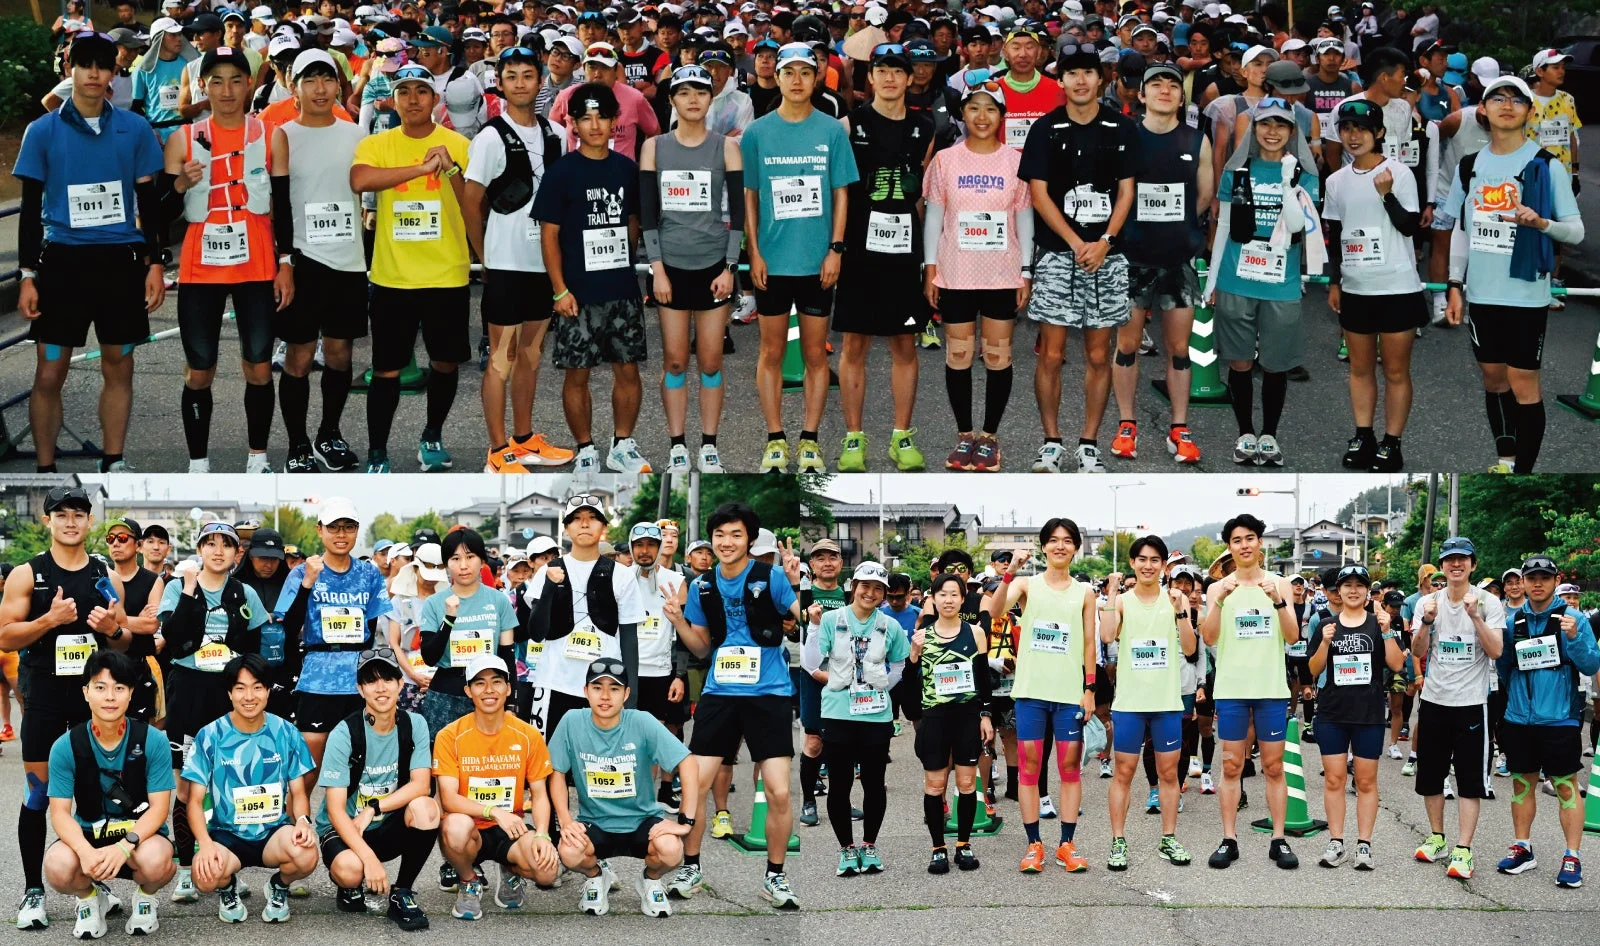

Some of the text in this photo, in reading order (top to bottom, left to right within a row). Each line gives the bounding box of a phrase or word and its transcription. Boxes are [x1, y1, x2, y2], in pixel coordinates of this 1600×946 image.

[764, 155, 826, 166] ULTRAMARATHON
[958, 174, 1004, 186] NAGOYA
[586, 188, 602, 201] RUN
[668, 188, 690, 196] 3001
[812, 192, 818, 200] A
[113, 198, 120, 206] A
[780, 194, 802, 204] 1002
[1144, 199, 1166, 208] 1004
[1176, 198, 1181, 206] A
[78, 200, 103, 211] 1011
[592, 202, 598, 212] &
[1072, 200, 1093, 208] 1001
[313, 219, 337, 228] 1014
[346, 218, 352, 226] A
[399, 218, 421, 226] 1062
[432, 216, 438, 224] B
[588, 212, 608, 226] TRAIL
[874, 228, 896, 238] 1007
[964, 227, 988, 236] 3004
[998, 226, 1003, 234] A
[1478, 228, 1500, 238] 1010
[207, 241, 230, 250] 1015
[240, 238, 246, 246] A
[1373, 242, 1380, 250] A
[592, 245, 615, 255] 1019
[1345, 244, 1364, 252] 3002
[1244, 255, 1267, 266] 3005
[1276, 258, 1282, 266] A
[312, 590, 370, 605] SAROMA
[958, 612, 977, 620] Style
[328, 622, 347, 630] 1057
[356, 620, 361, 628] B
[1240, 620, 1258, 628] 5005
[572, 637, 592, 646] 1063
[1036, 633, 1056, 642] 5007
[1332, 640, 1360, 648] NORTH
[200, 649, 222, 658] 3502
[456, 645, 477, 654] 3501
[1442, 646, 1459, 654] 5011
[62, 652, 86, 660] 1061
[1522, 650, 1542, 660] 5003
[720, 662, 741, 670] 1055
[462, 754, 521, 765] HIDA TAKAYAMA
[462, 763, 521, 772] ULTRAMARATHON
[593, 777, 615, 786] 1052
[474, 792, 496, 801] 1053
[506, 790, 511, 798] B
[242, 802, 264, 811] 1054
